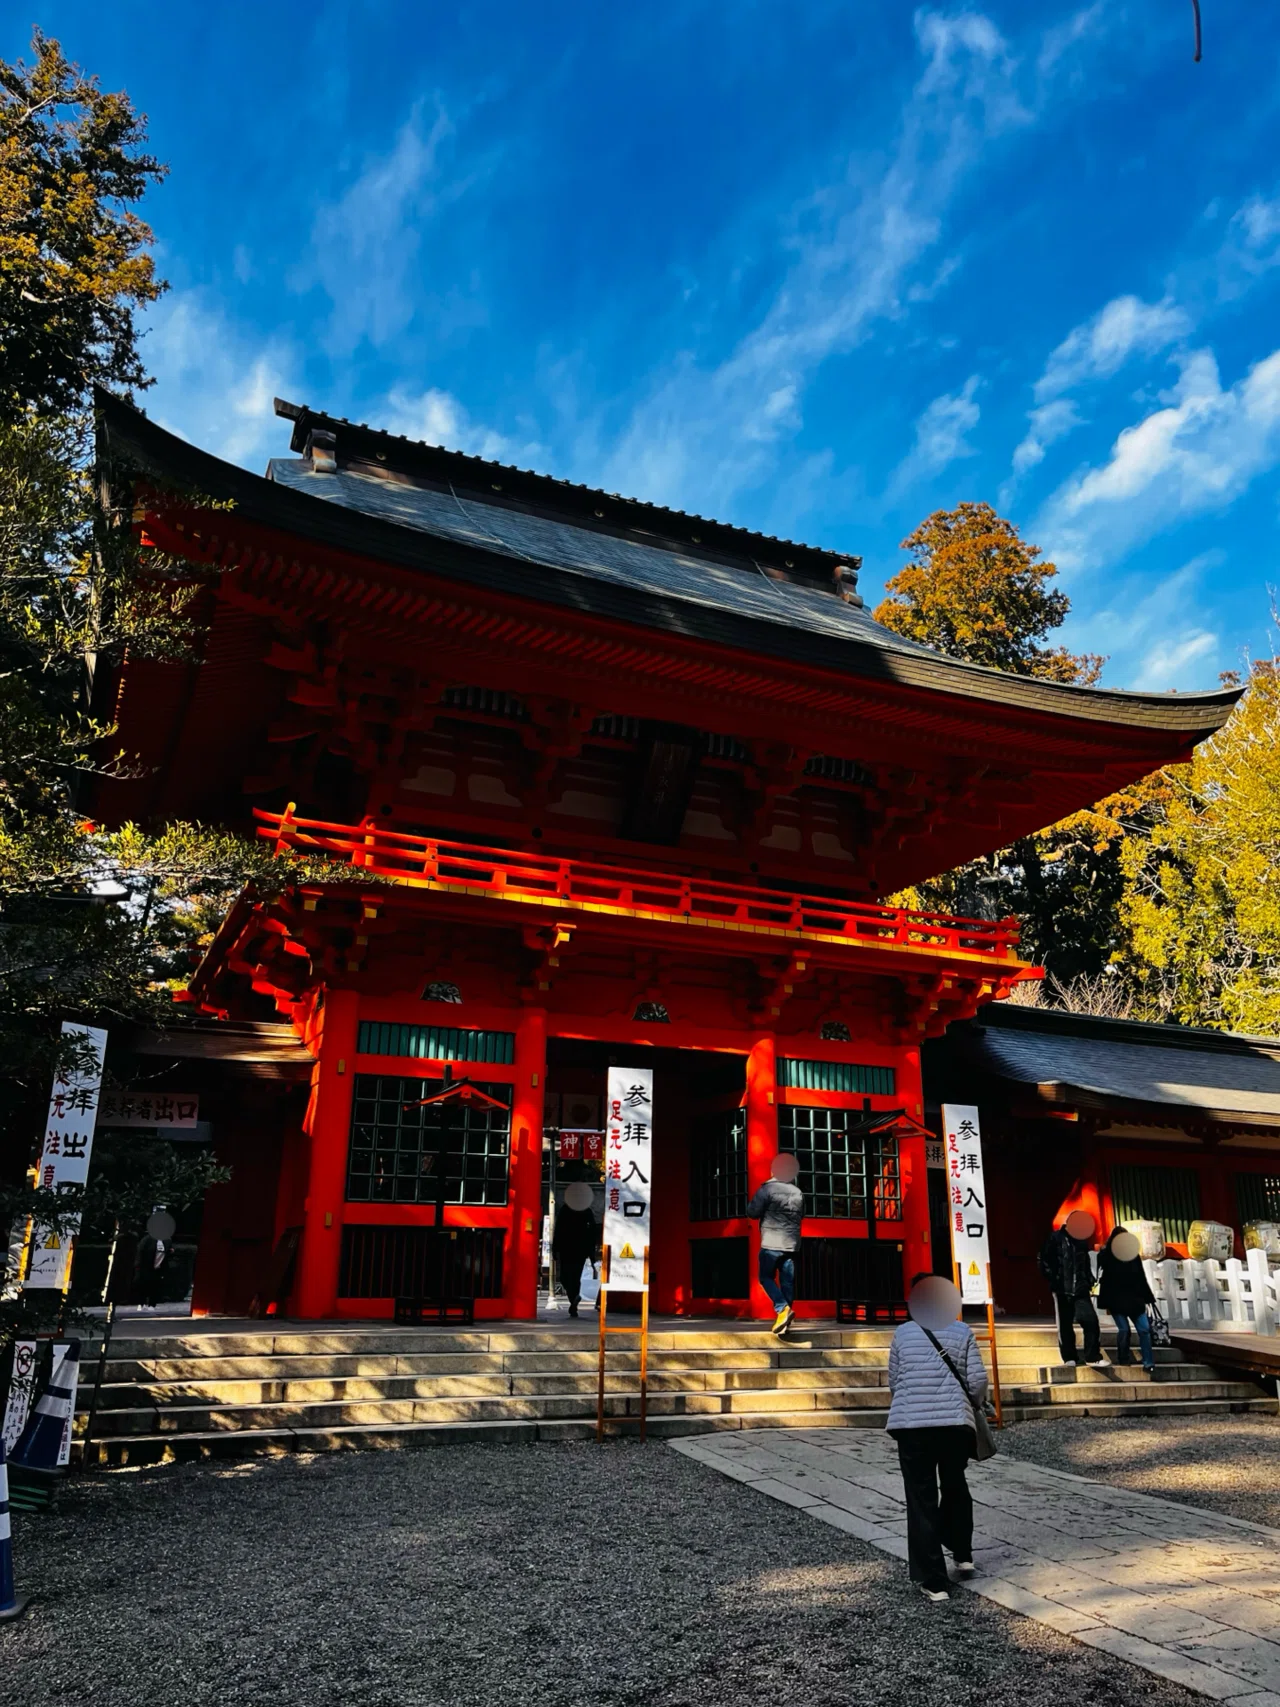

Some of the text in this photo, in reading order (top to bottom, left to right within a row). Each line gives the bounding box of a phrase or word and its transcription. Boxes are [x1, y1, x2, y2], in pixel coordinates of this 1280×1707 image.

[101, 1096, 198, 1123] 参拝者出口
[608, 1100, 624, 1211] 足元注意
[622, 1085, 651, 1218] 参拝入口
[948, 1133, 965, 1233] 足元注意
[957, 1119, 985, 1238] 参拝入口
